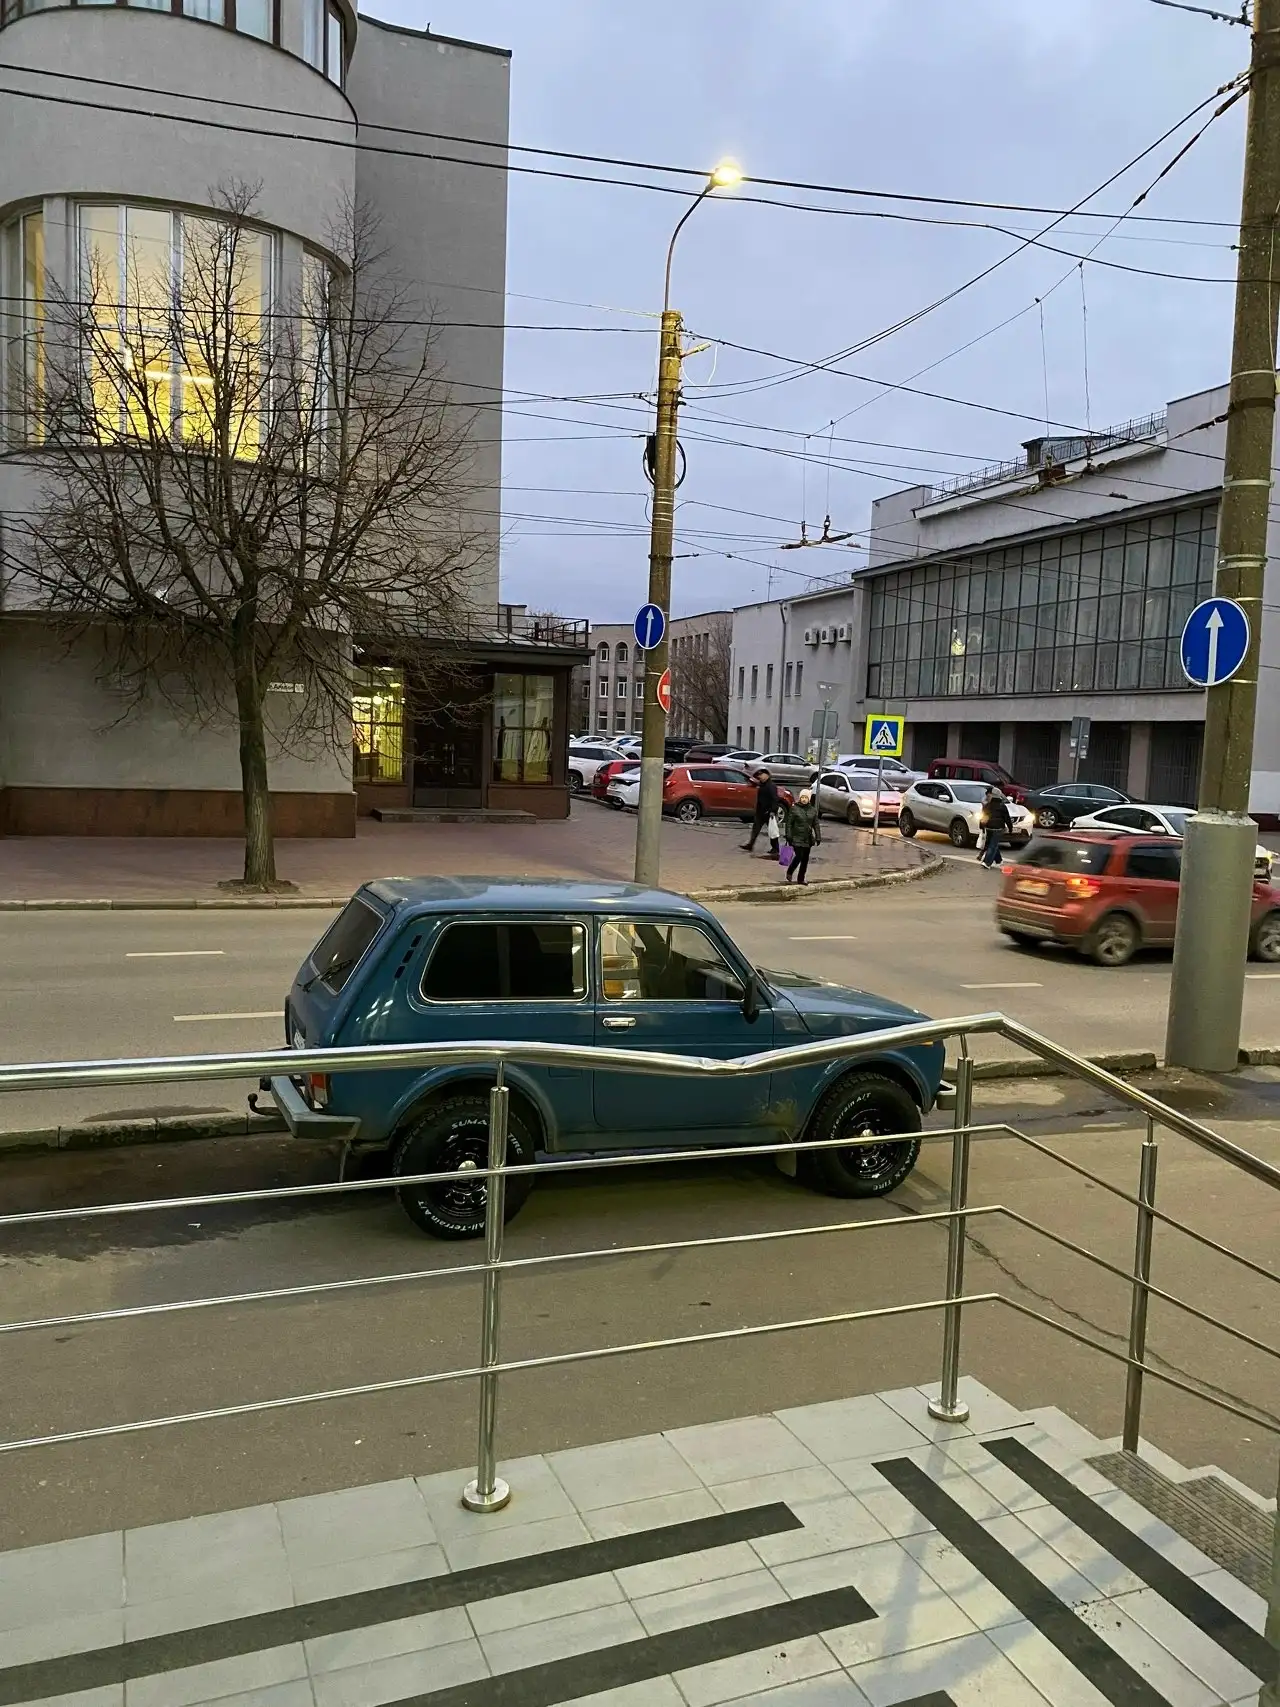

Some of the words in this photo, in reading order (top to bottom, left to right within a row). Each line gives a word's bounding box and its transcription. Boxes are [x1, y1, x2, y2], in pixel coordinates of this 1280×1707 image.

[830, 1100, 855, 1140] ll-Terrain
[451, 1118, 488, 1130] SUMA
[507, 1132, 524, 1157] TIRE
[872, 1179, 892, 1191] TIRE
[417, 1199, 433, 1216] A/T
[430, 1214, 486, 1232] All-Terrain
